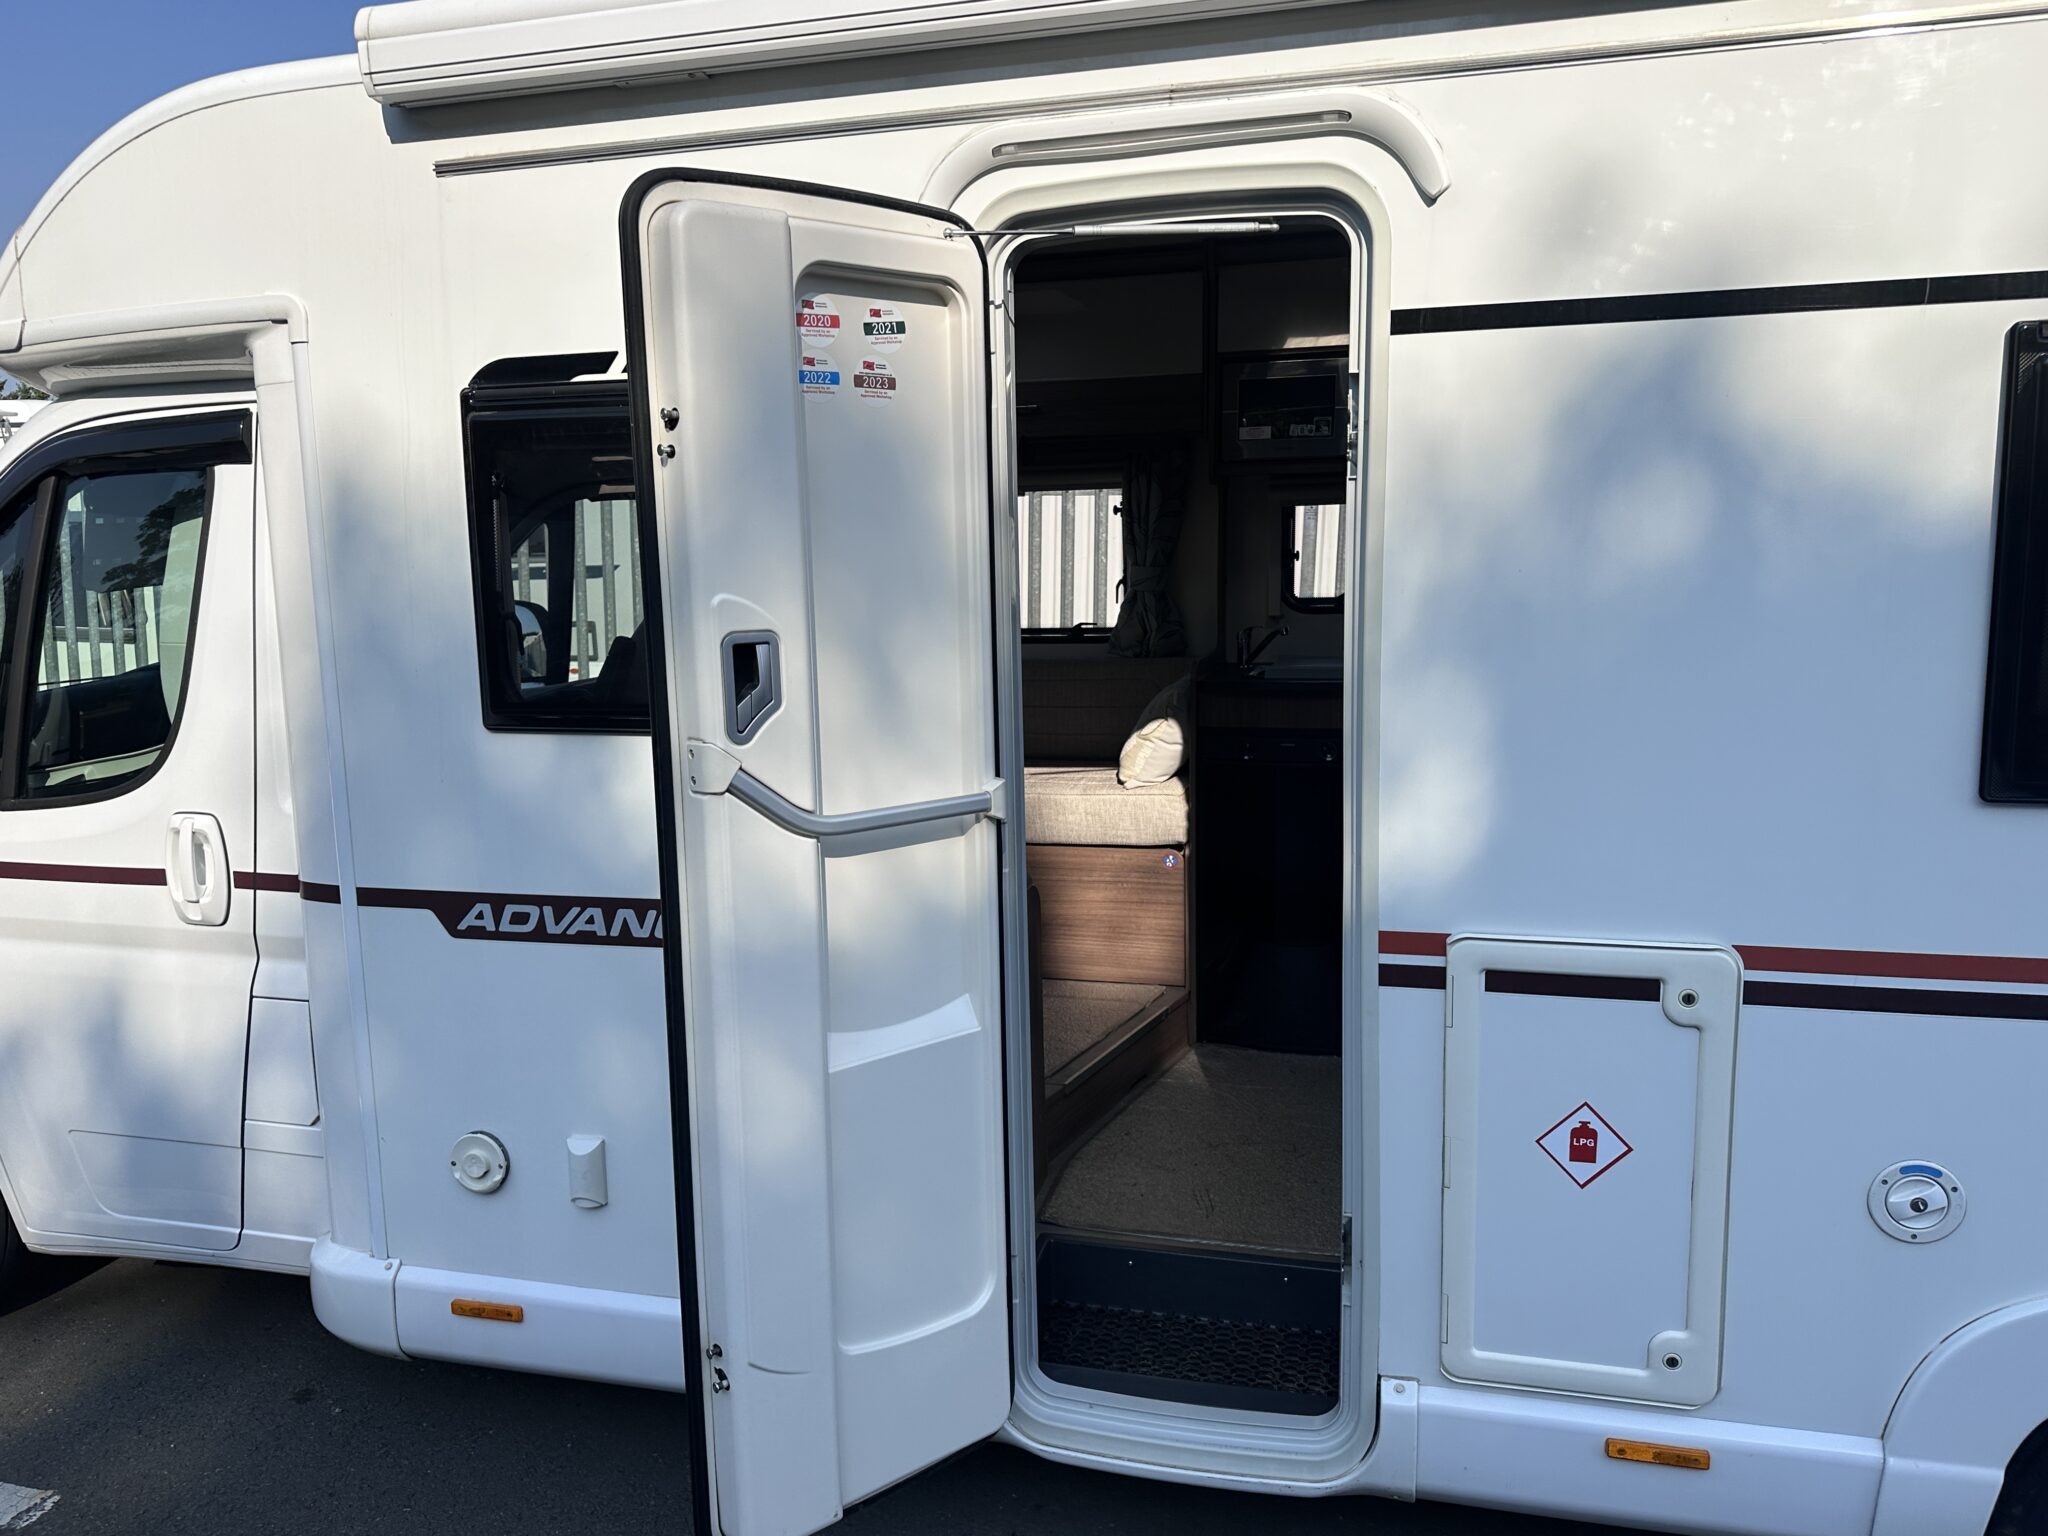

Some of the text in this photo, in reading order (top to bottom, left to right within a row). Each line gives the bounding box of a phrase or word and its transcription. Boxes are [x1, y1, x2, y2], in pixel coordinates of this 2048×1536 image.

[803, 314, 831, 327] 2020
[872, 322, 897, 334] 2021
[803, 371, 831, 384] 2022
[863, 376, 889, 389] 2023
[1573, 1138, 1595, 1147] LPG
